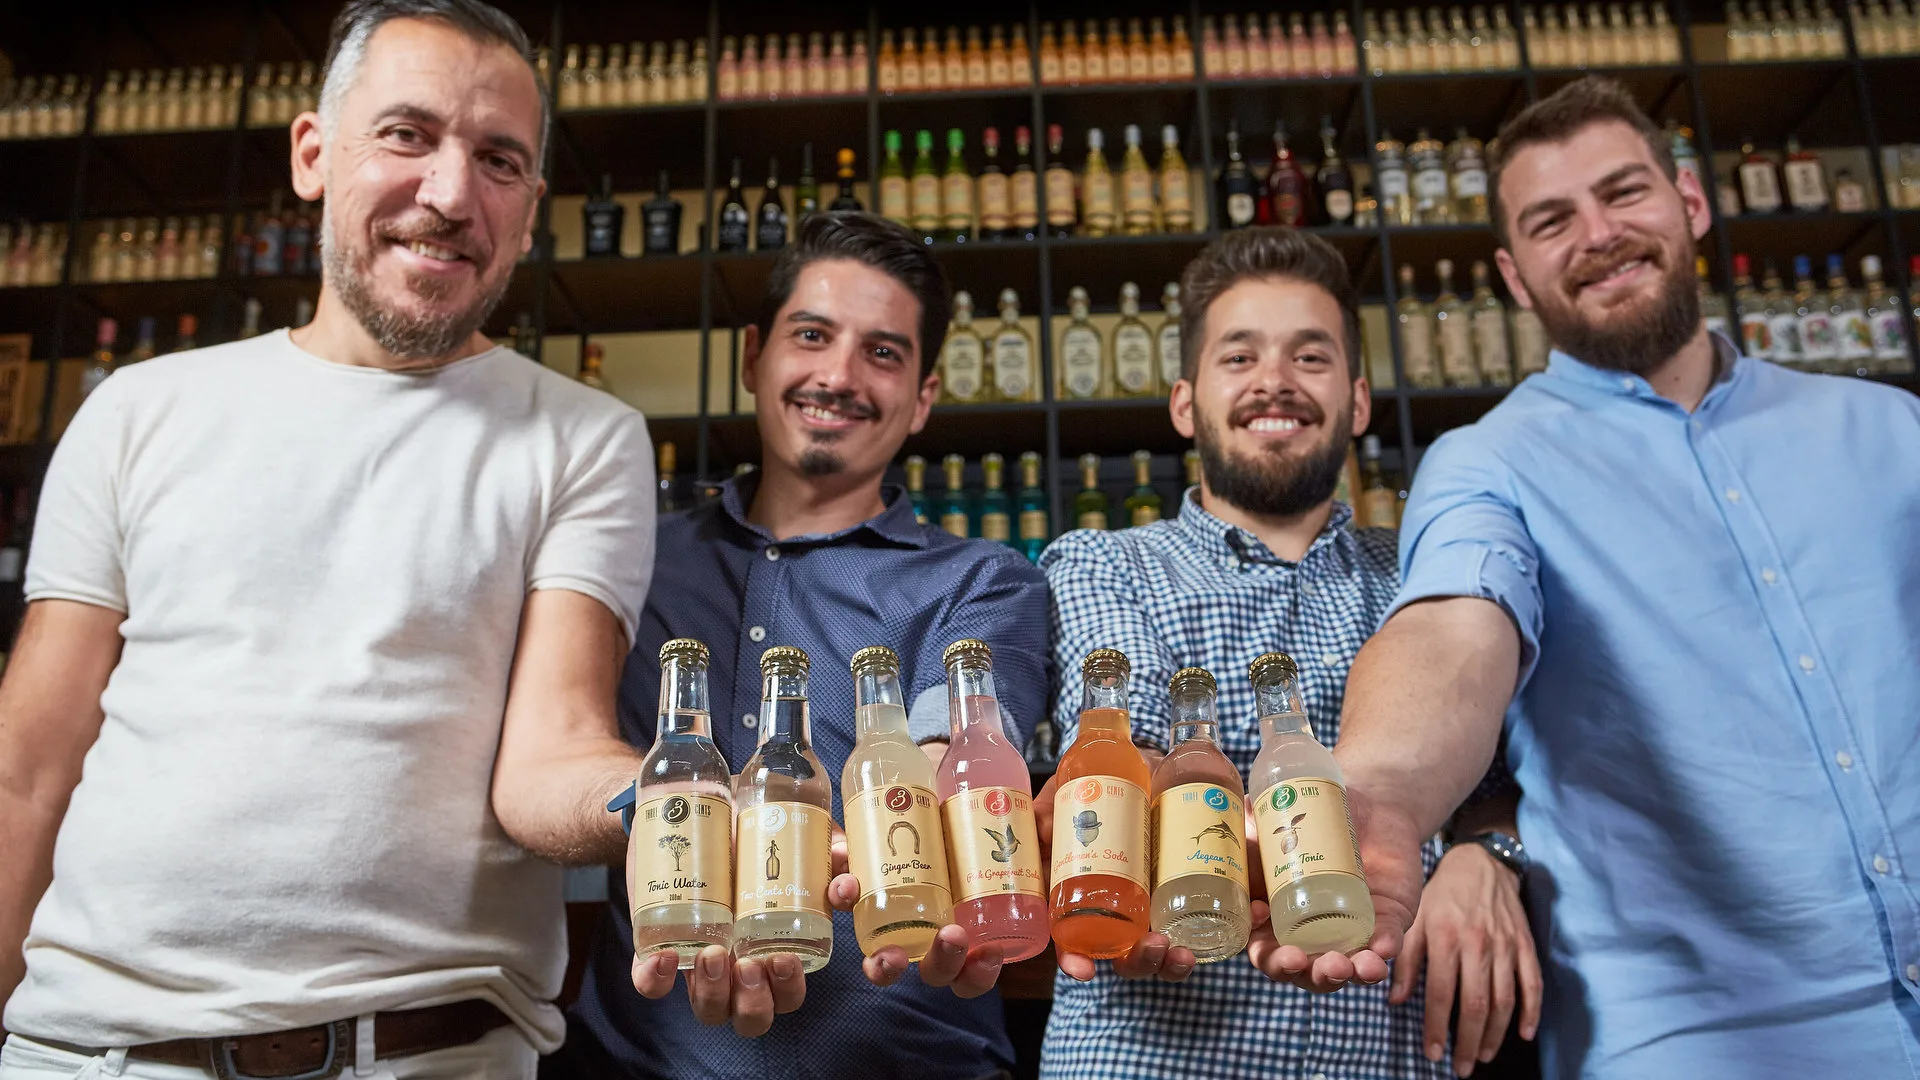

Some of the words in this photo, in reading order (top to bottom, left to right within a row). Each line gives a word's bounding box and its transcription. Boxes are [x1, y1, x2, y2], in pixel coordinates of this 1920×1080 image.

[1300, 786, 1320, 796] CENTS
[1102, 848, 1129, 863] Soda
[1186, 849, 1226, 864] Aegean
[1226, 855, 1244, 873] Tonic
[1298, 852, 1325, 864] Tonic
[880, 862, 911, 876] Ginger
[911, 859, 932, 870] Beer
[984, 867, 1025, 881] Grapefruit
[1025, 868, 1041, 881] Soda
[1214, 867, 1227, 876] 200ml
[647, 880, 670, 893] Tonic
[673, 877, 708, 889] Water
[902, 876, 916, 884] 200ml
[755, 884, 784, 898] Cents
[785, 881, 811, 897] Plain
[669, 893, 683, 901] 200ml
[765, 900, 778, 909] 200ml
